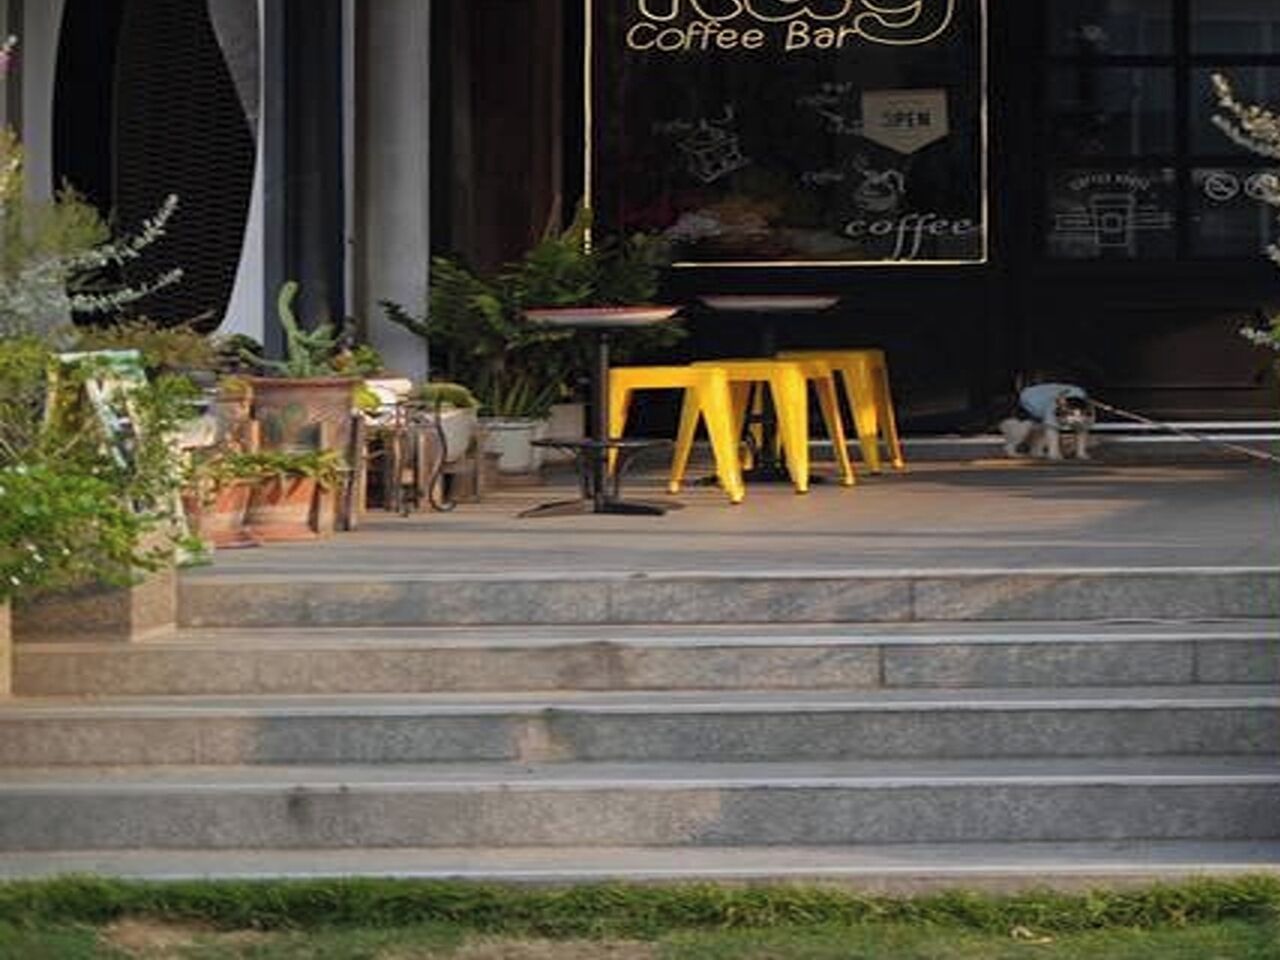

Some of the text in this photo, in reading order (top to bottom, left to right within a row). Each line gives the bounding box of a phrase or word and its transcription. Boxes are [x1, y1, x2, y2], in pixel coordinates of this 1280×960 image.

[626, 20, 861, 51] Coffee Bar
[844, 212, 976, 259] coffee
